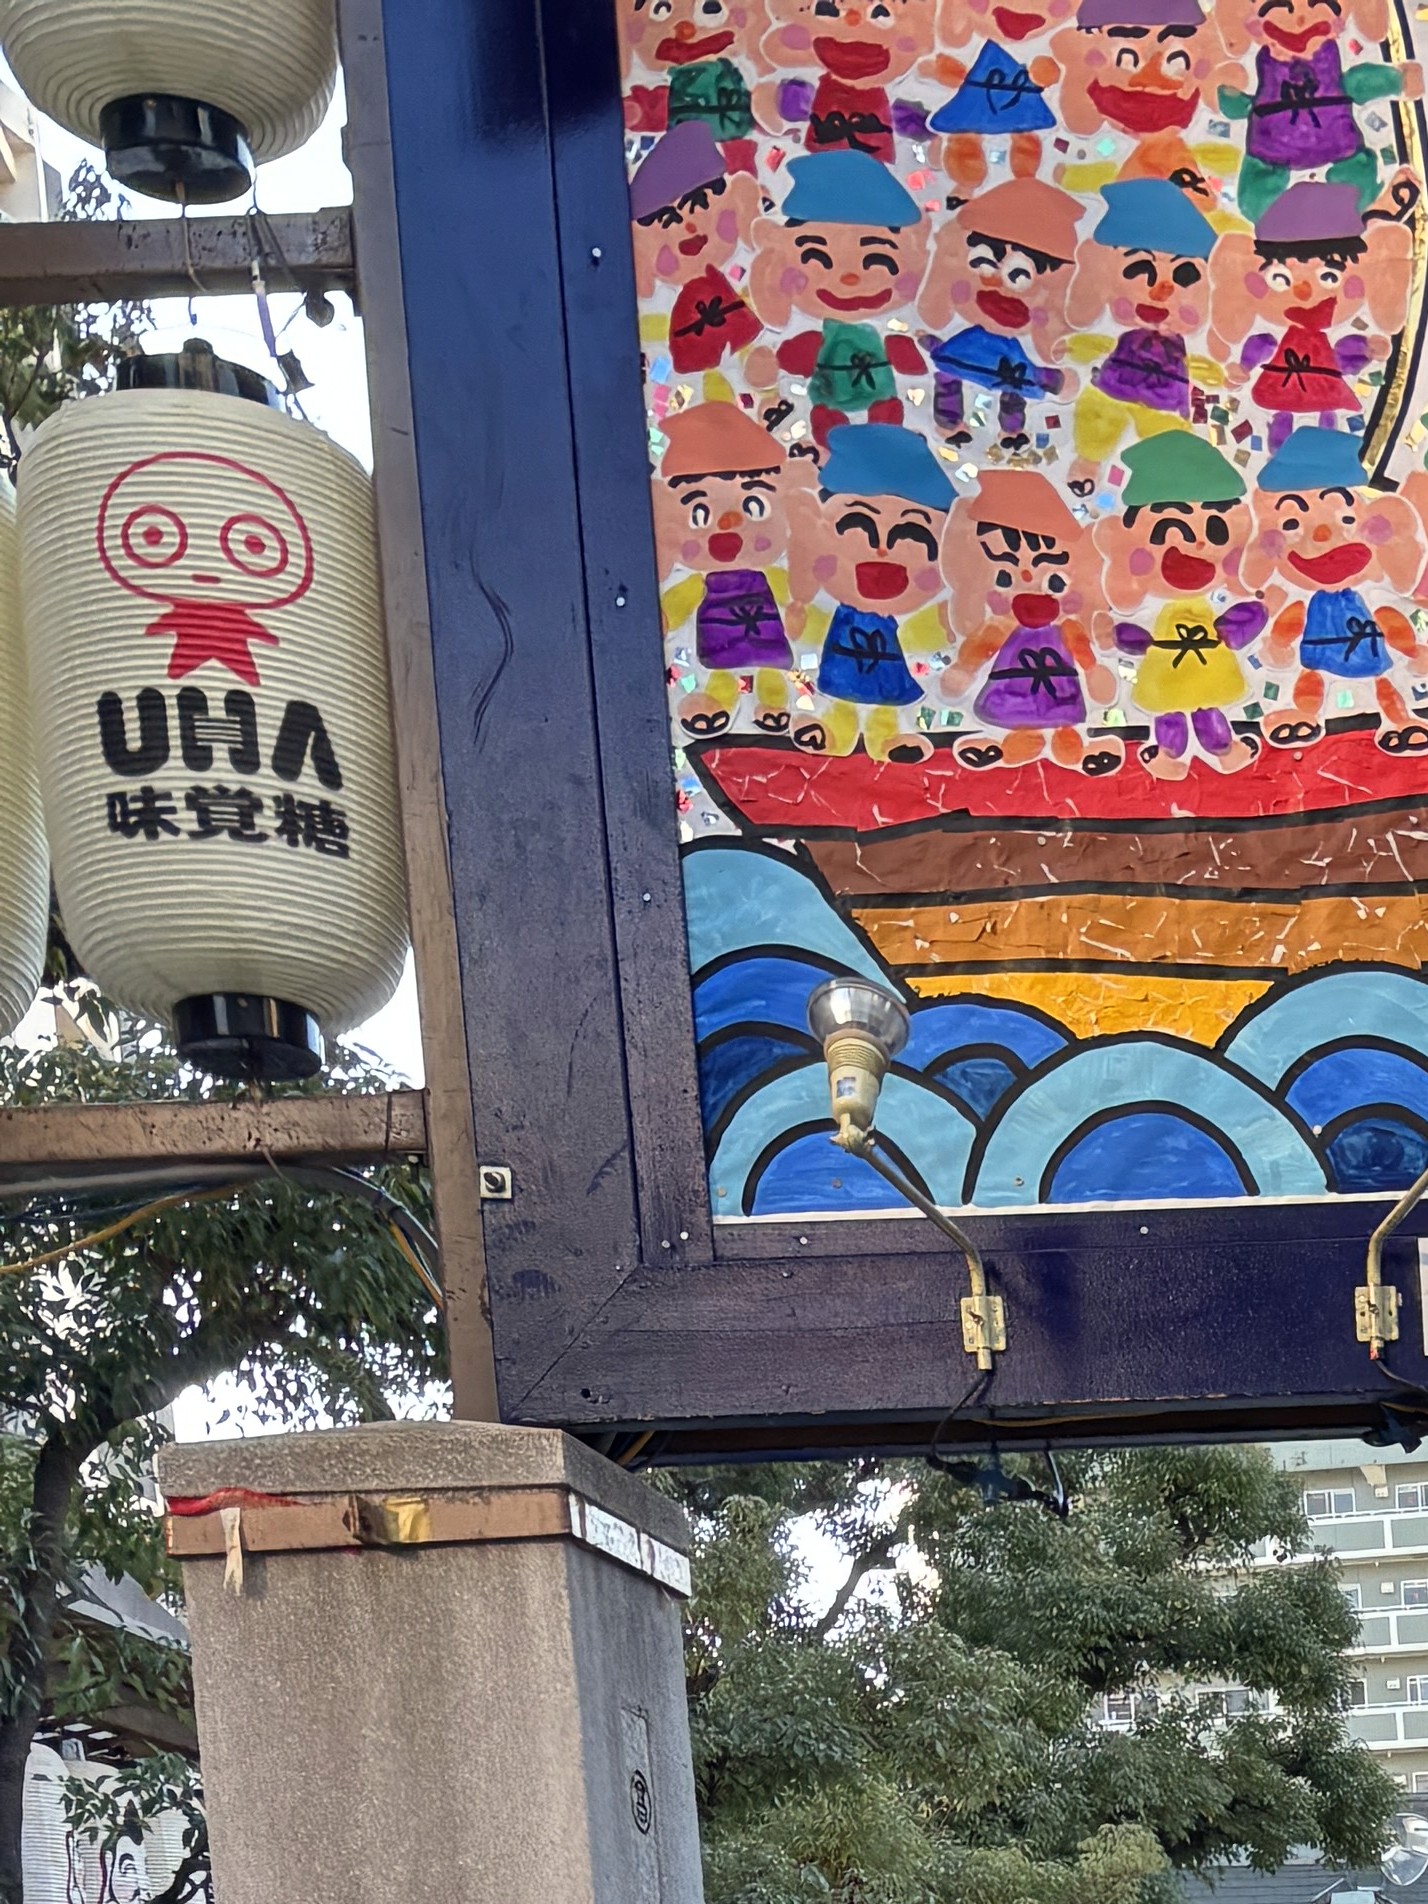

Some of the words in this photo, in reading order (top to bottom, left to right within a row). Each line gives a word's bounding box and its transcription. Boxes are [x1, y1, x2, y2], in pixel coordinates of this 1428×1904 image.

[96, 686, 344, 792] UHA
[106, 785, 352, 860] 味覚糖
